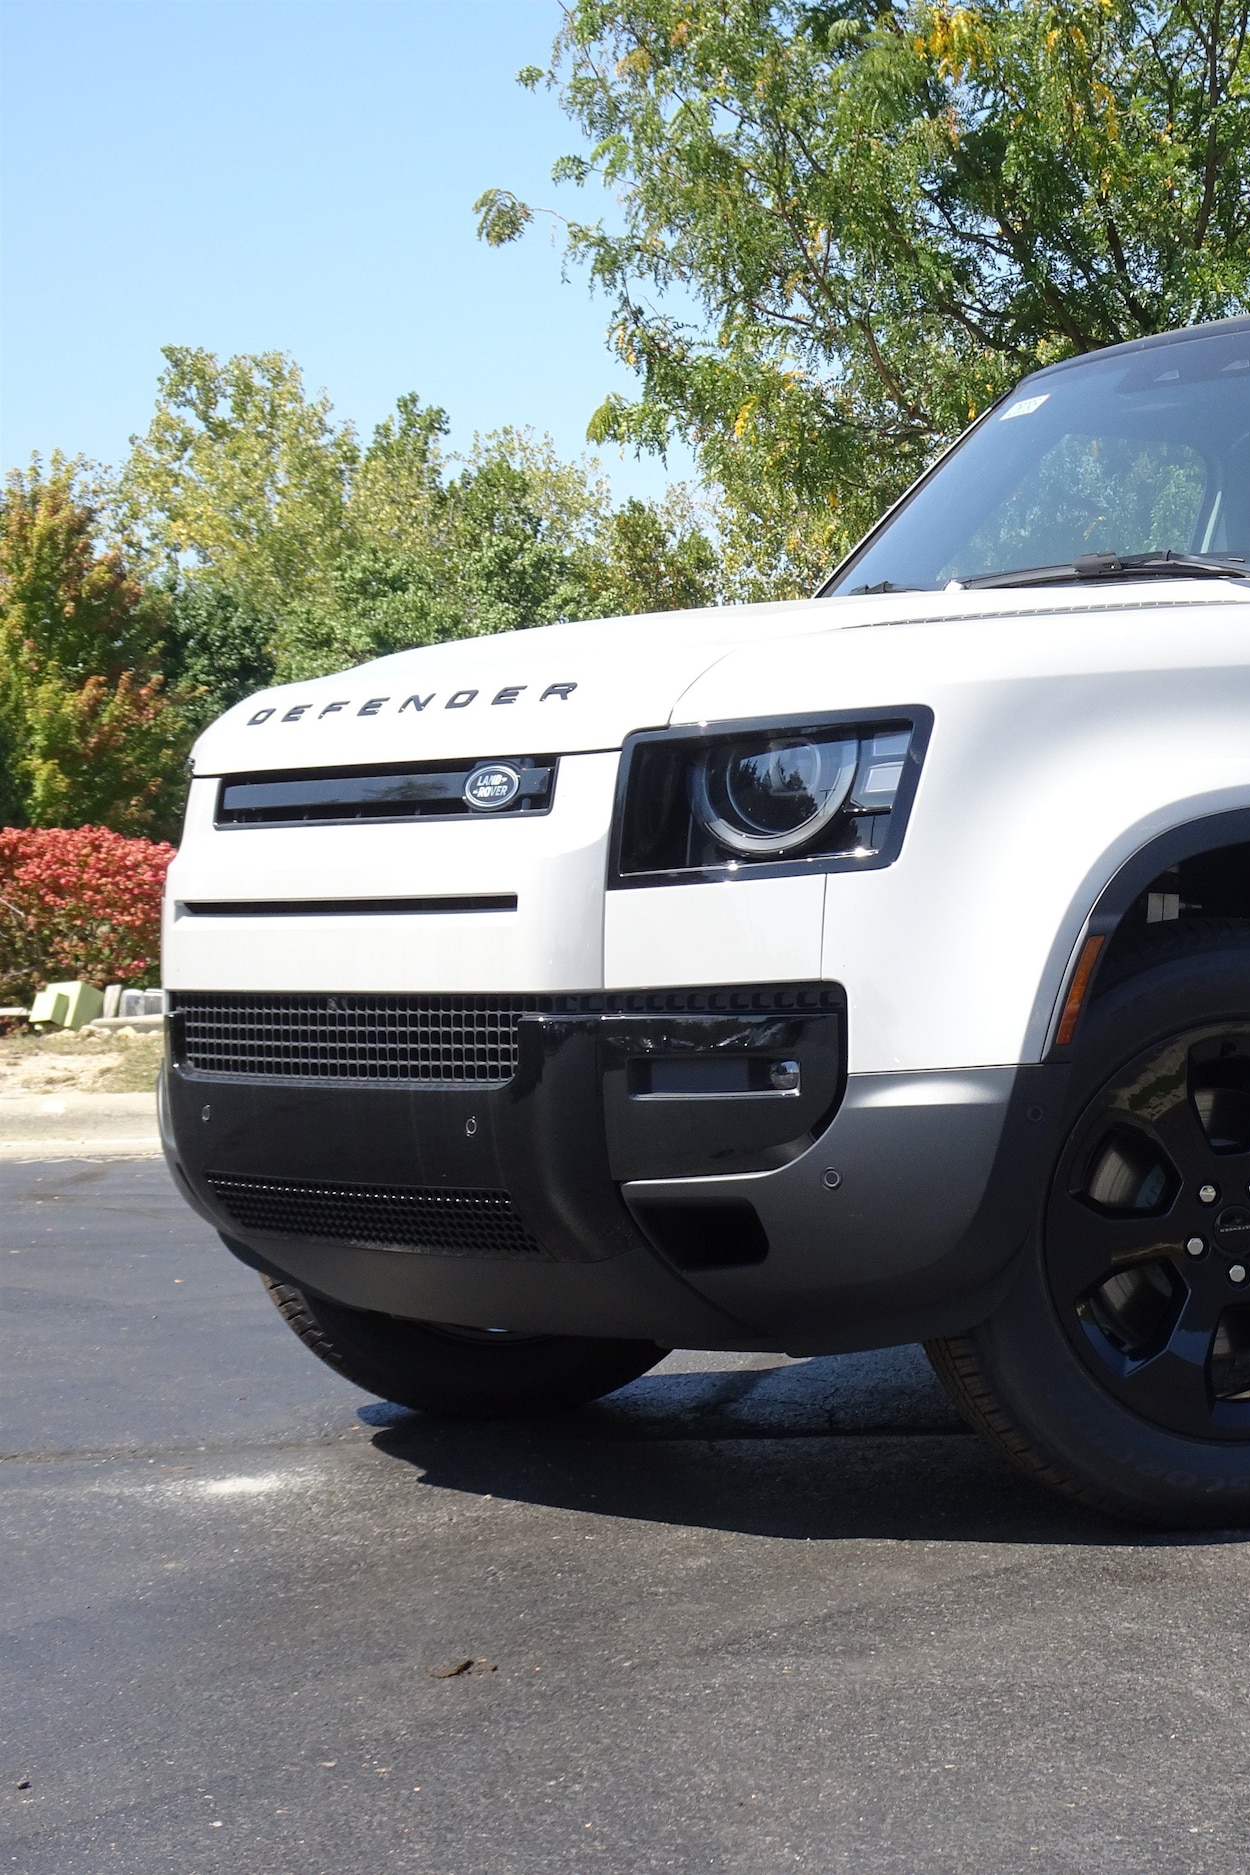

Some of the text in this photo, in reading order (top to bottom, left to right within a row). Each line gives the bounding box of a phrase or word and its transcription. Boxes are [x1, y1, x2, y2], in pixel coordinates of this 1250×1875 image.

[246, 682, 578, 726] DEFENDER
[477, 774, 503, 786] LAND
[477, 785, 508, 798] ROVER
